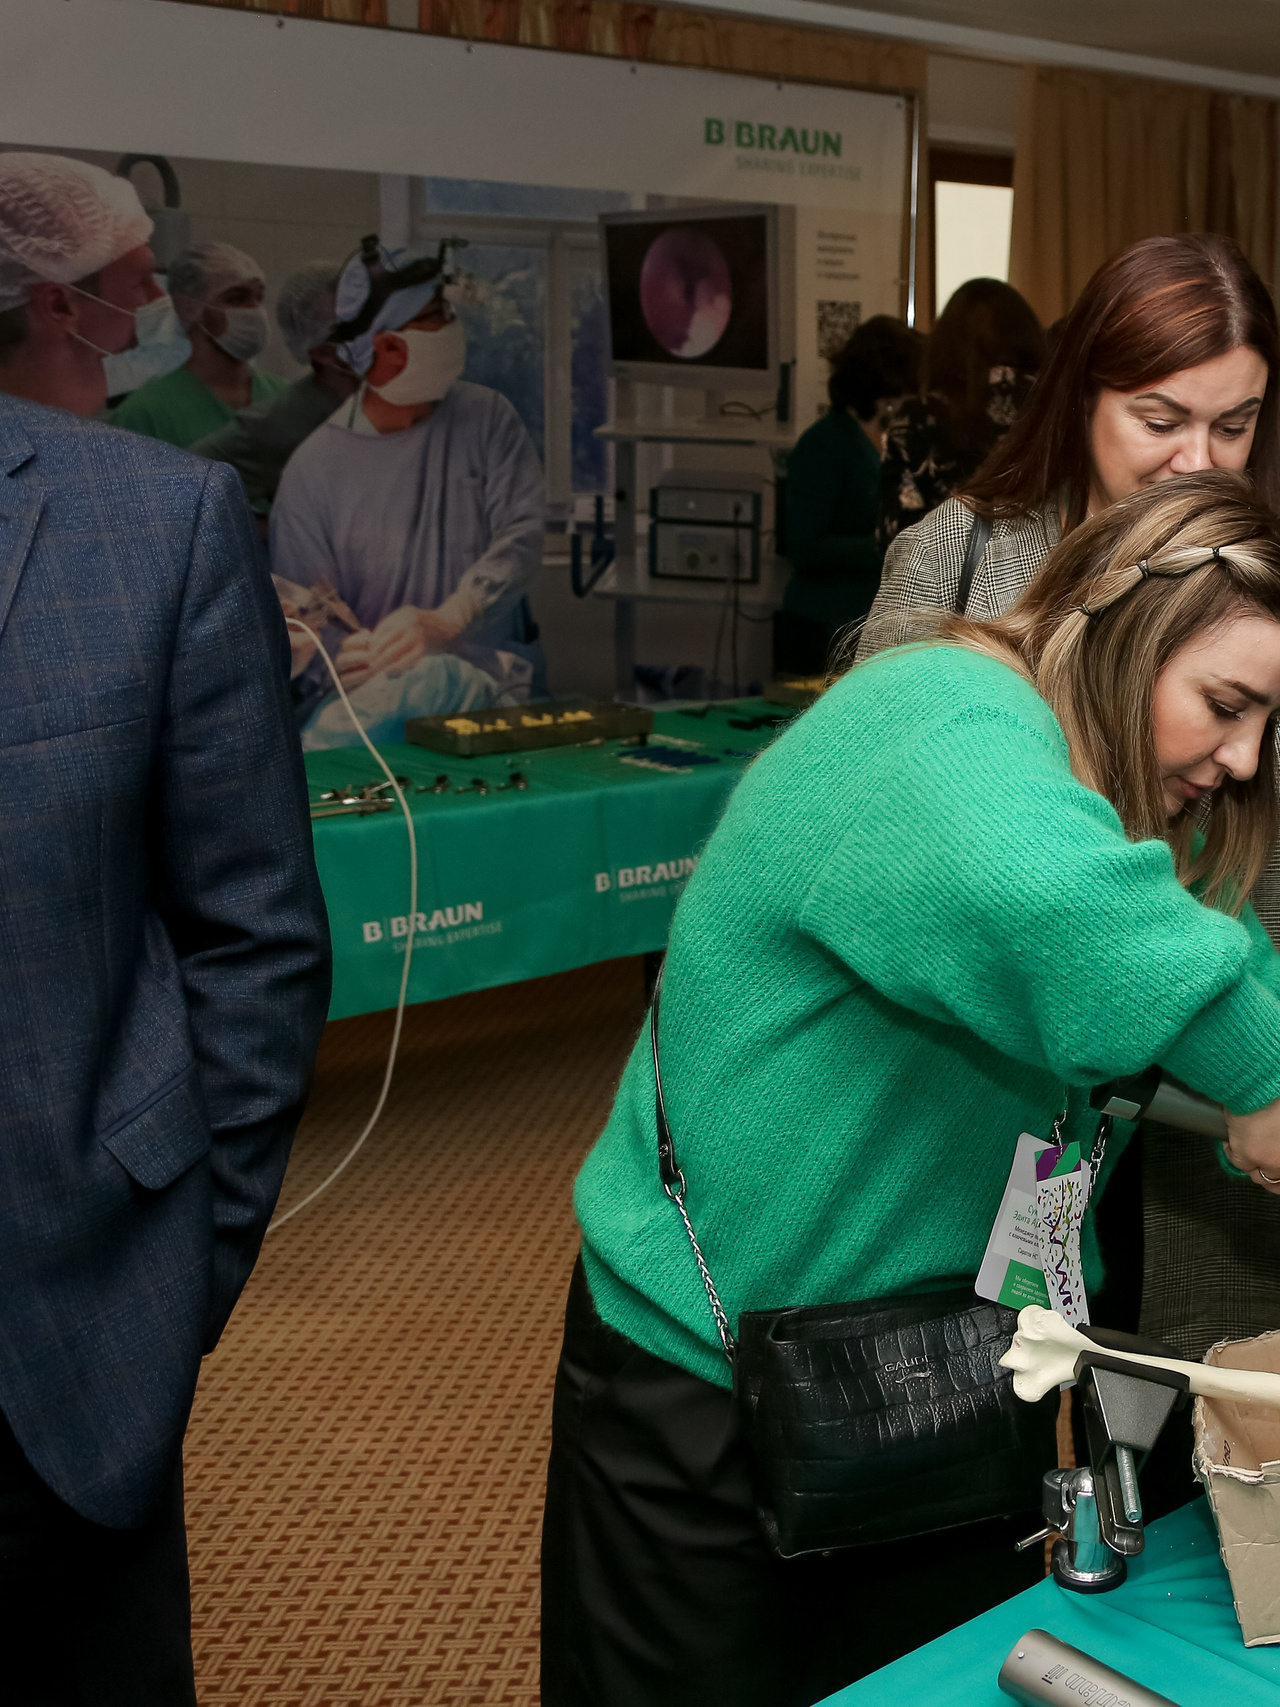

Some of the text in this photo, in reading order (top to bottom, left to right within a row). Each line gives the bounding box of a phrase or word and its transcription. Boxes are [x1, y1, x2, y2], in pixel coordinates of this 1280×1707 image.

[704, 117, 842, 157] B BRAUN
[595, 872, 611, 893] B
[362, 902, 483, 943] B BRAUN
